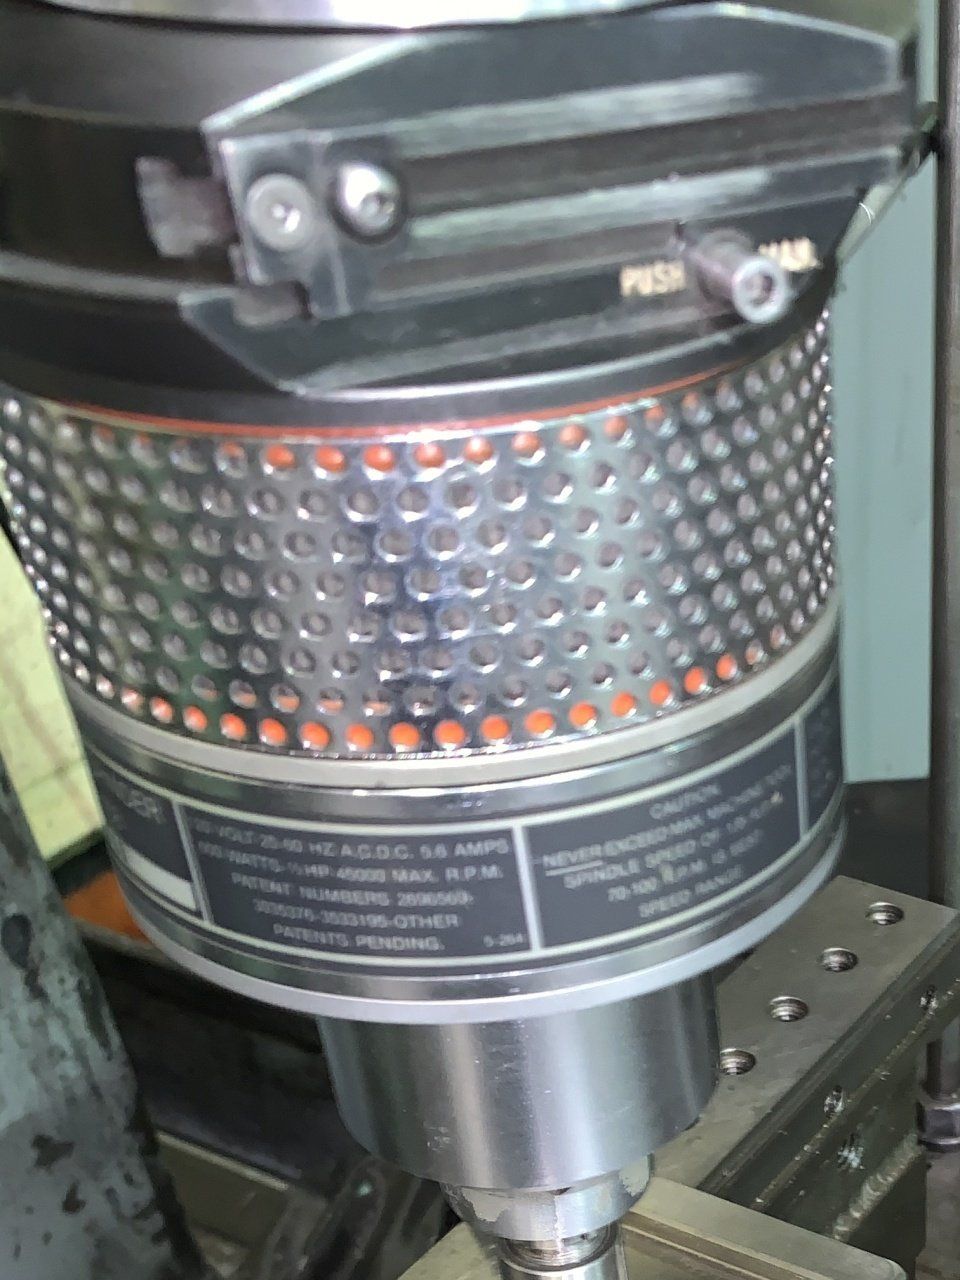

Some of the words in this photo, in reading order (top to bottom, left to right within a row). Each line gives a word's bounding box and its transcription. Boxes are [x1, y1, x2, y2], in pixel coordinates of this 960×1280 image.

[454, 838, 509, 857] AMPS
[543, 844, 602, 867] NEVER
[273, 923, 349, 948] PATENTS
